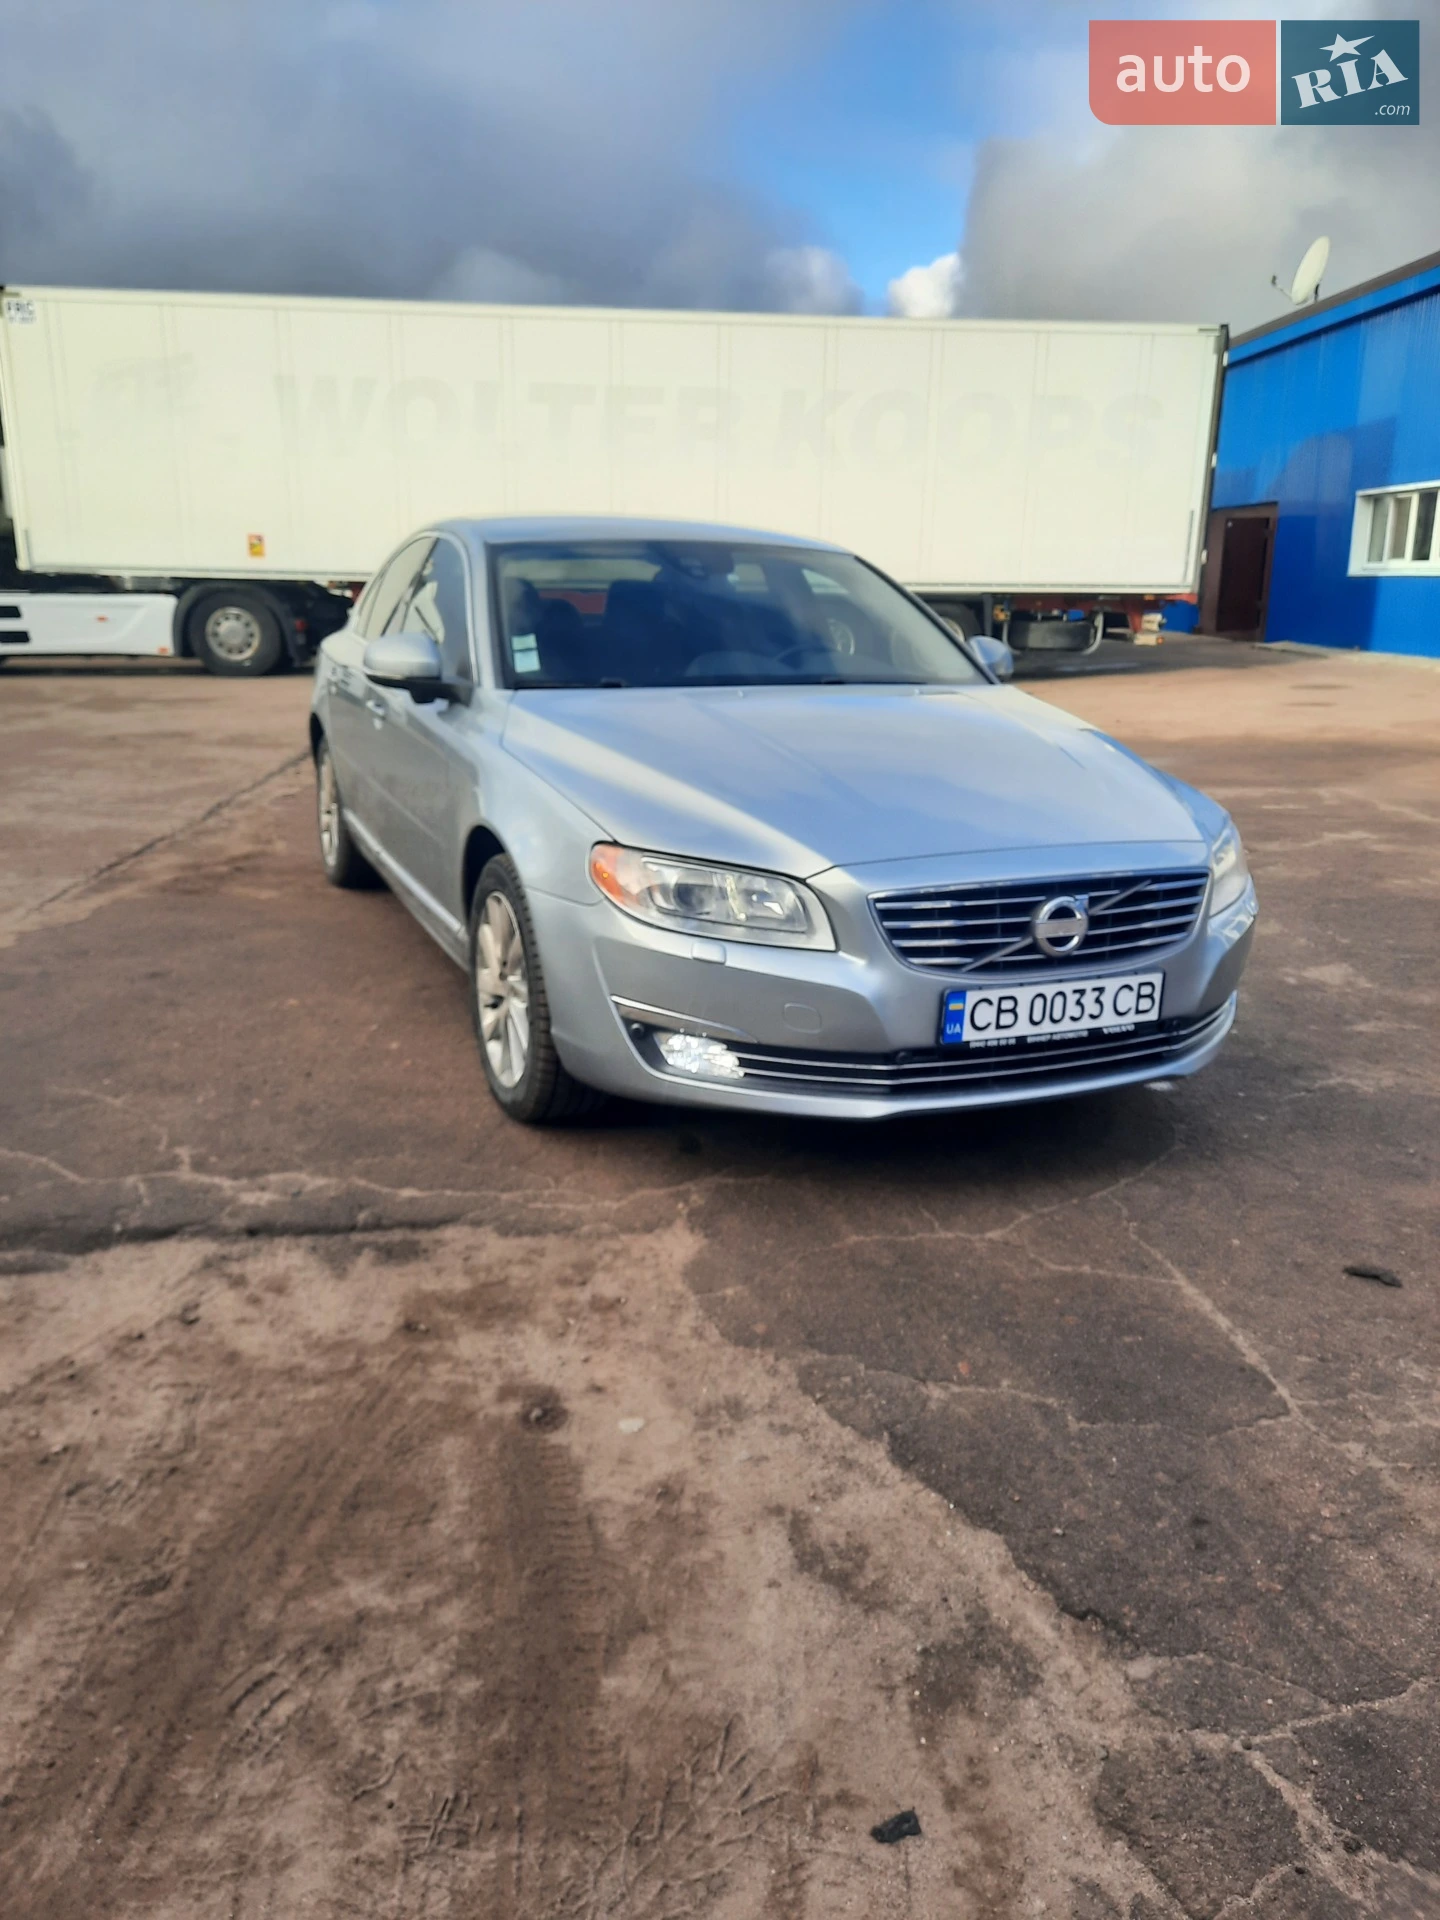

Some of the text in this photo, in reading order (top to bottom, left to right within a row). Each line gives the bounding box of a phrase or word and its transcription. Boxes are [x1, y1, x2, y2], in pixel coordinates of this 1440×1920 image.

[274, 373, 1162, 474] WOLTER KOOPS
[946, 1023, 962, 1035] UA
[969, 981, 1156, 1032] CB 0033 CB
